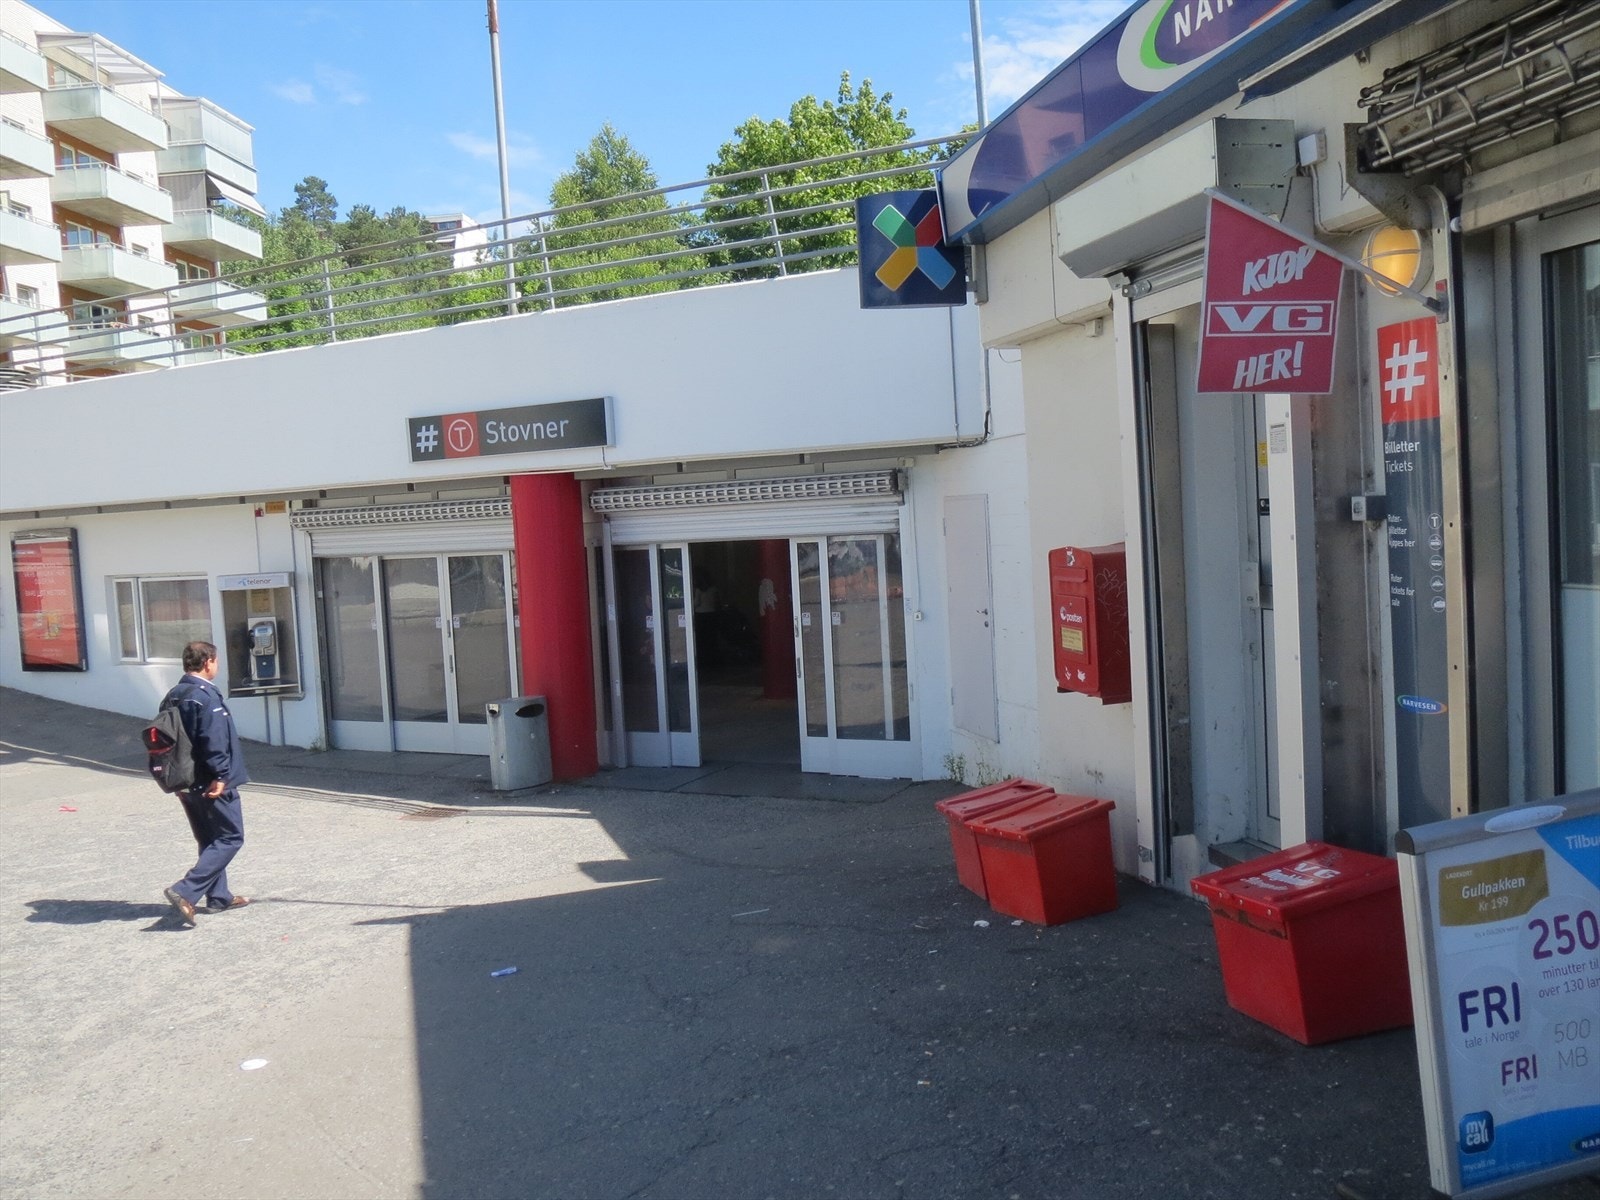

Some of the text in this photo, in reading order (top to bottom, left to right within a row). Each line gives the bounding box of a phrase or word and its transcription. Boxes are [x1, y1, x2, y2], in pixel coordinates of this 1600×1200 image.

[1242, 245, 1317, 296] KJØP
[1214, 305, 1324, 332] VG
[1232, 341, 1305, 390] HER!
[485, 418, 569, 444] Stovner
[1384, 440, 1420, 454] Billetter
[1385, 460, 1414, 473] Tickets
[1404, 539, 1416, 548] her
[247, 577, 272, 586] telenor
[1406, 587, 1416, 596] for
[1066, 613, 1083, 624] posten
[1402, 698, 1437, 710] NARVESEN
[1565, 834, 1600, 849] Tilbu
[1294, 862, 1341, 879] VG
[1461, 876, 1526, 899] Gullpakken
[1478, 896, 1509, 912] Kr 199
[1528, 910, 1600, 960] 250
[1542, 961, 1586, 980] minutter
[1538, 985, 1560, 998] over
[1564, 978, 1585, 994] 130
[1458, 982, 1521, 1033] FRI
[1464, 1036, 1482, 1049] tale
[1491, 1029, 1520, 1043] Norge
[1554, 1018, 1591, 1044] 500
[1557, 1046, 1589, 1070] MB
[1501, 1053, 1538, 1087] FRI
[1466, 1119, 1487, 1143] my
[1466, 1127, 1489, 1146] call
